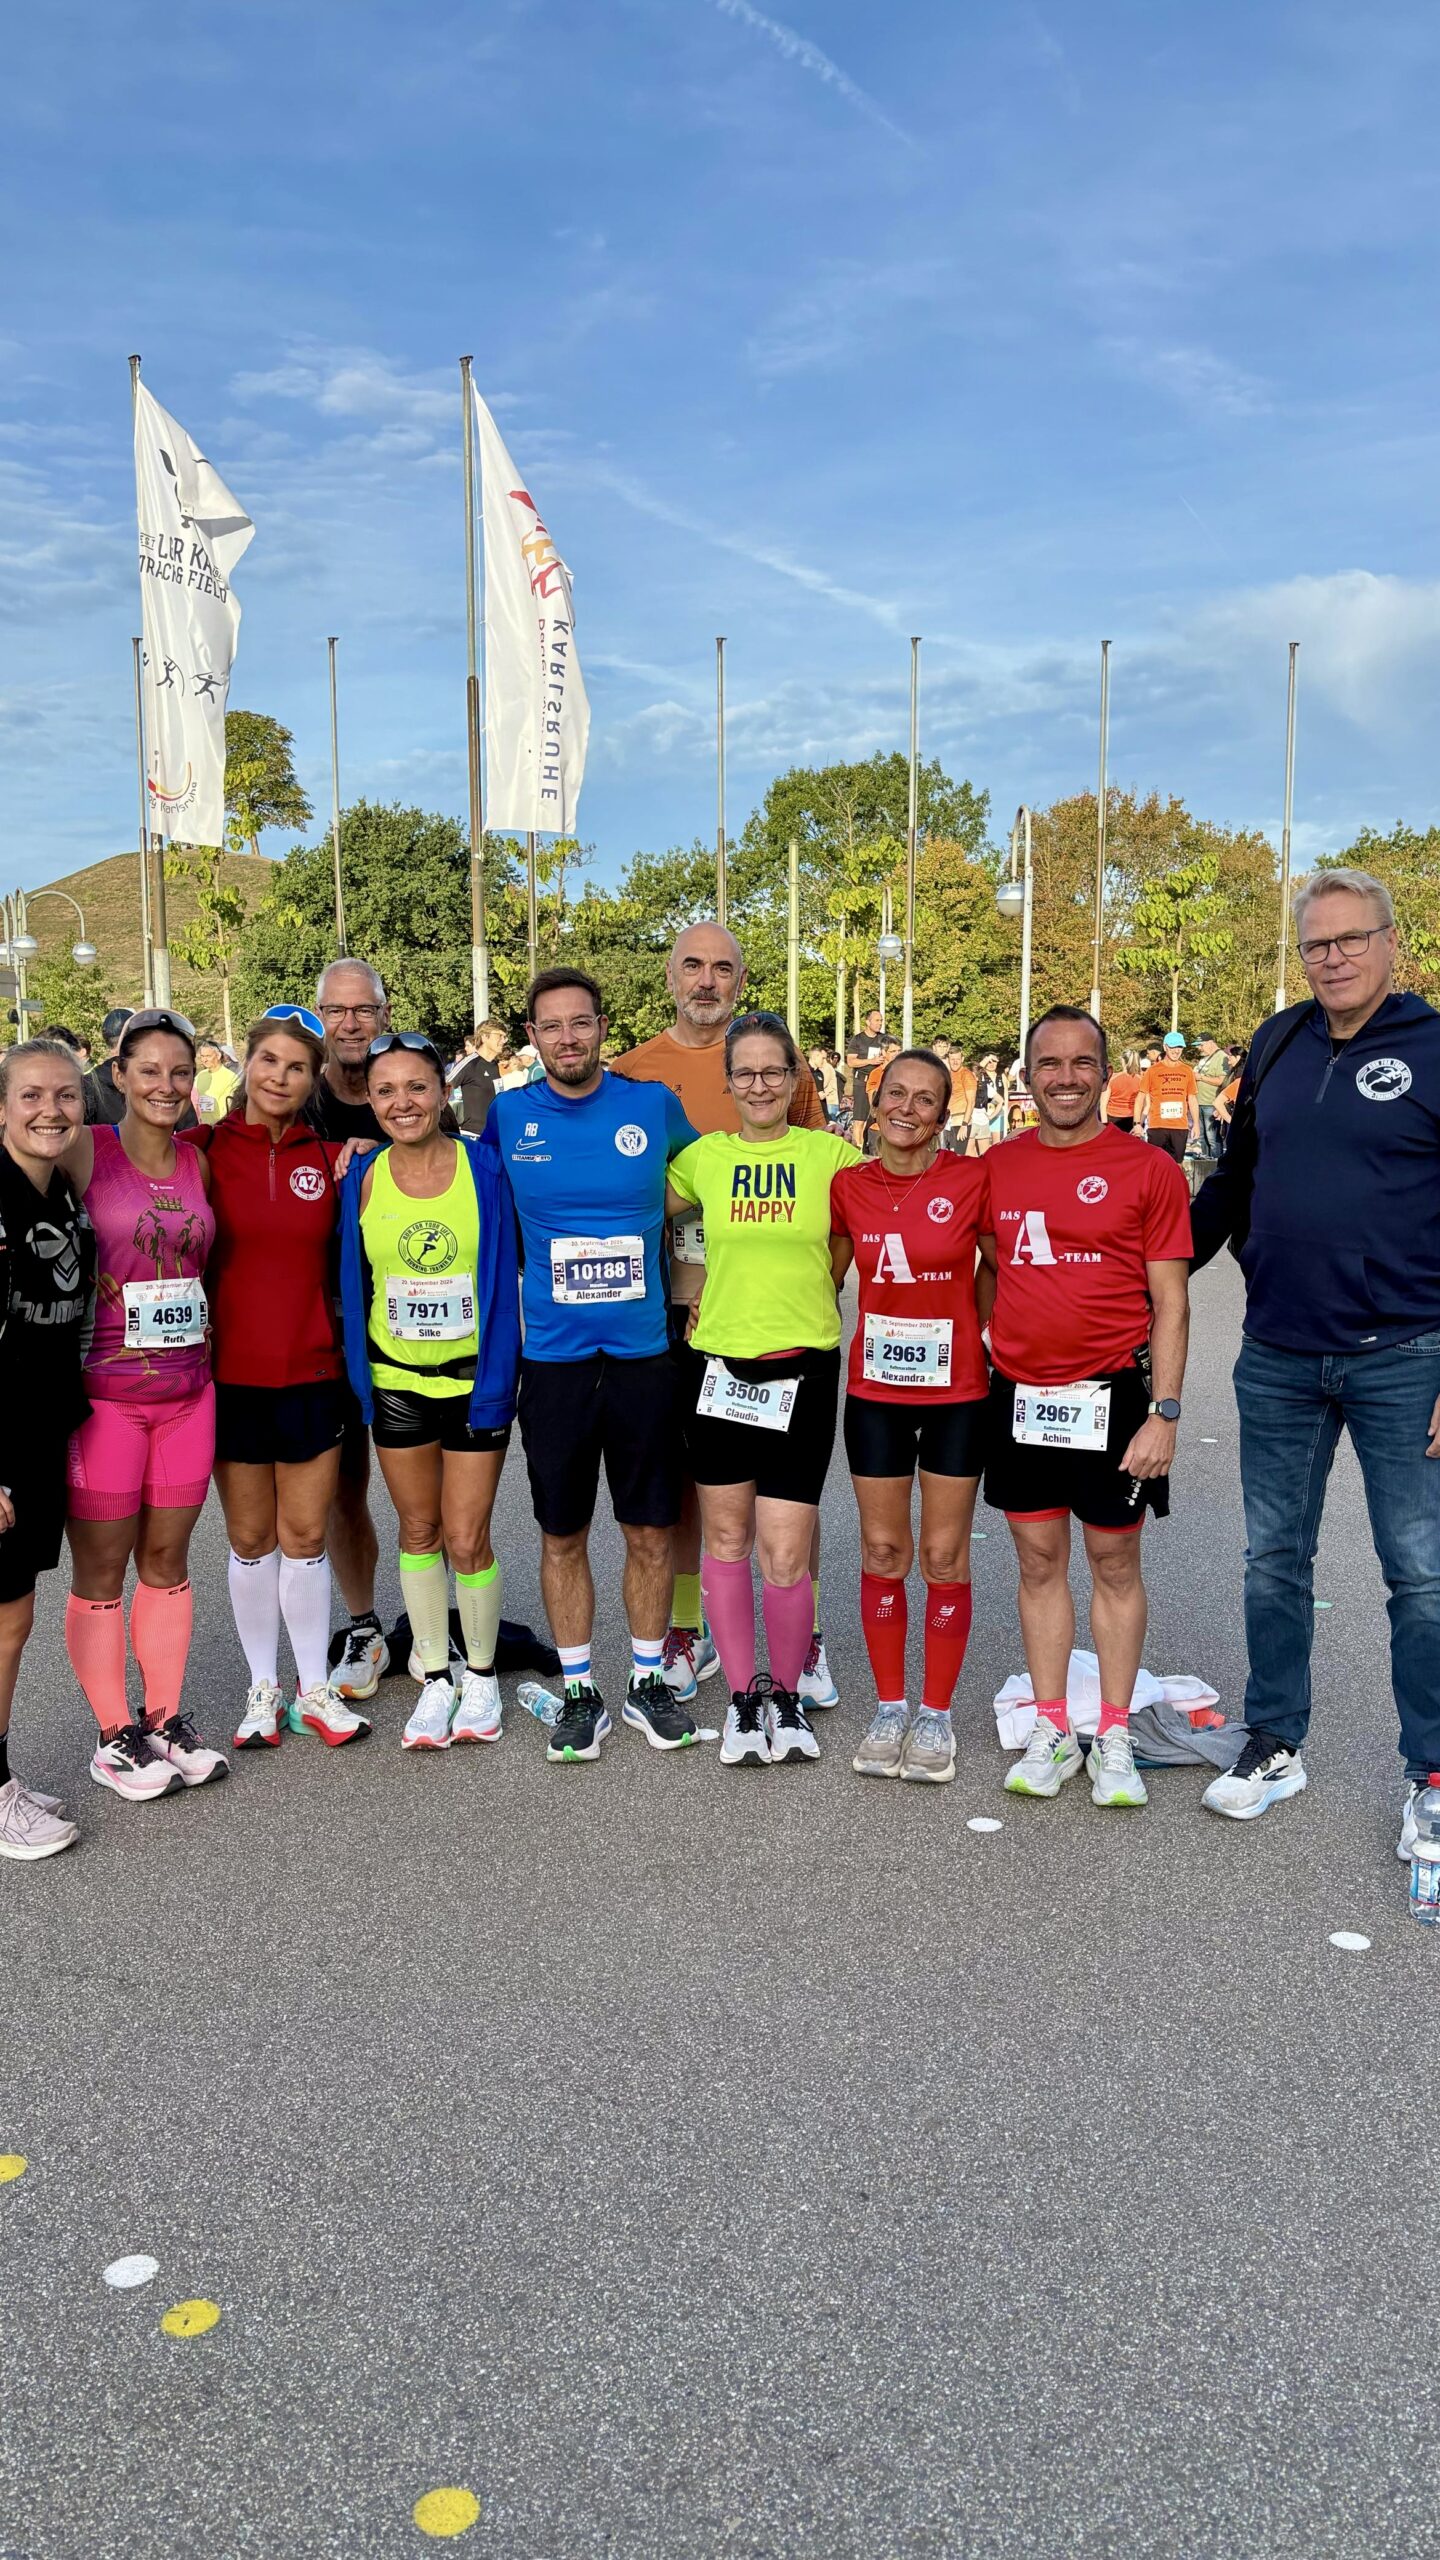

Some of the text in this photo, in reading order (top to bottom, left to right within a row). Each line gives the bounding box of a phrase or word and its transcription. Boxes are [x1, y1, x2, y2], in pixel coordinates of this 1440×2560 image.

[187, 569, 228, 604] FIELD
[298, 1175, 318, 1191] 42
[731, 1163, 796, 1199] RUN
[730, 1200, 796, 1223] HAPPY
[1000, 1211, 1021, 1221] DAS
[862, 1233, 881, 1243] DAS
[571, 1261, 627, 1281] 10188
[576, 1290, 622, 1300] Alexander
[152, 1306, 193, 1325] 4639
[407, 1302, 449, 1318] 7971
[163, 1335, 186, 1344] Ruth
[418, 1328, 441, 1337] Silke
[882, 1343, 927, 1363] 2963
[881, 1370, 926, 1383] Alexandra
[725, 1381, 771, 1404] 3500
[725, 1407, 759, 1422] Claudia
[1036, 1404, 1082, 1424] 2967
[1042, 1433, 1071, 1444] Achim
